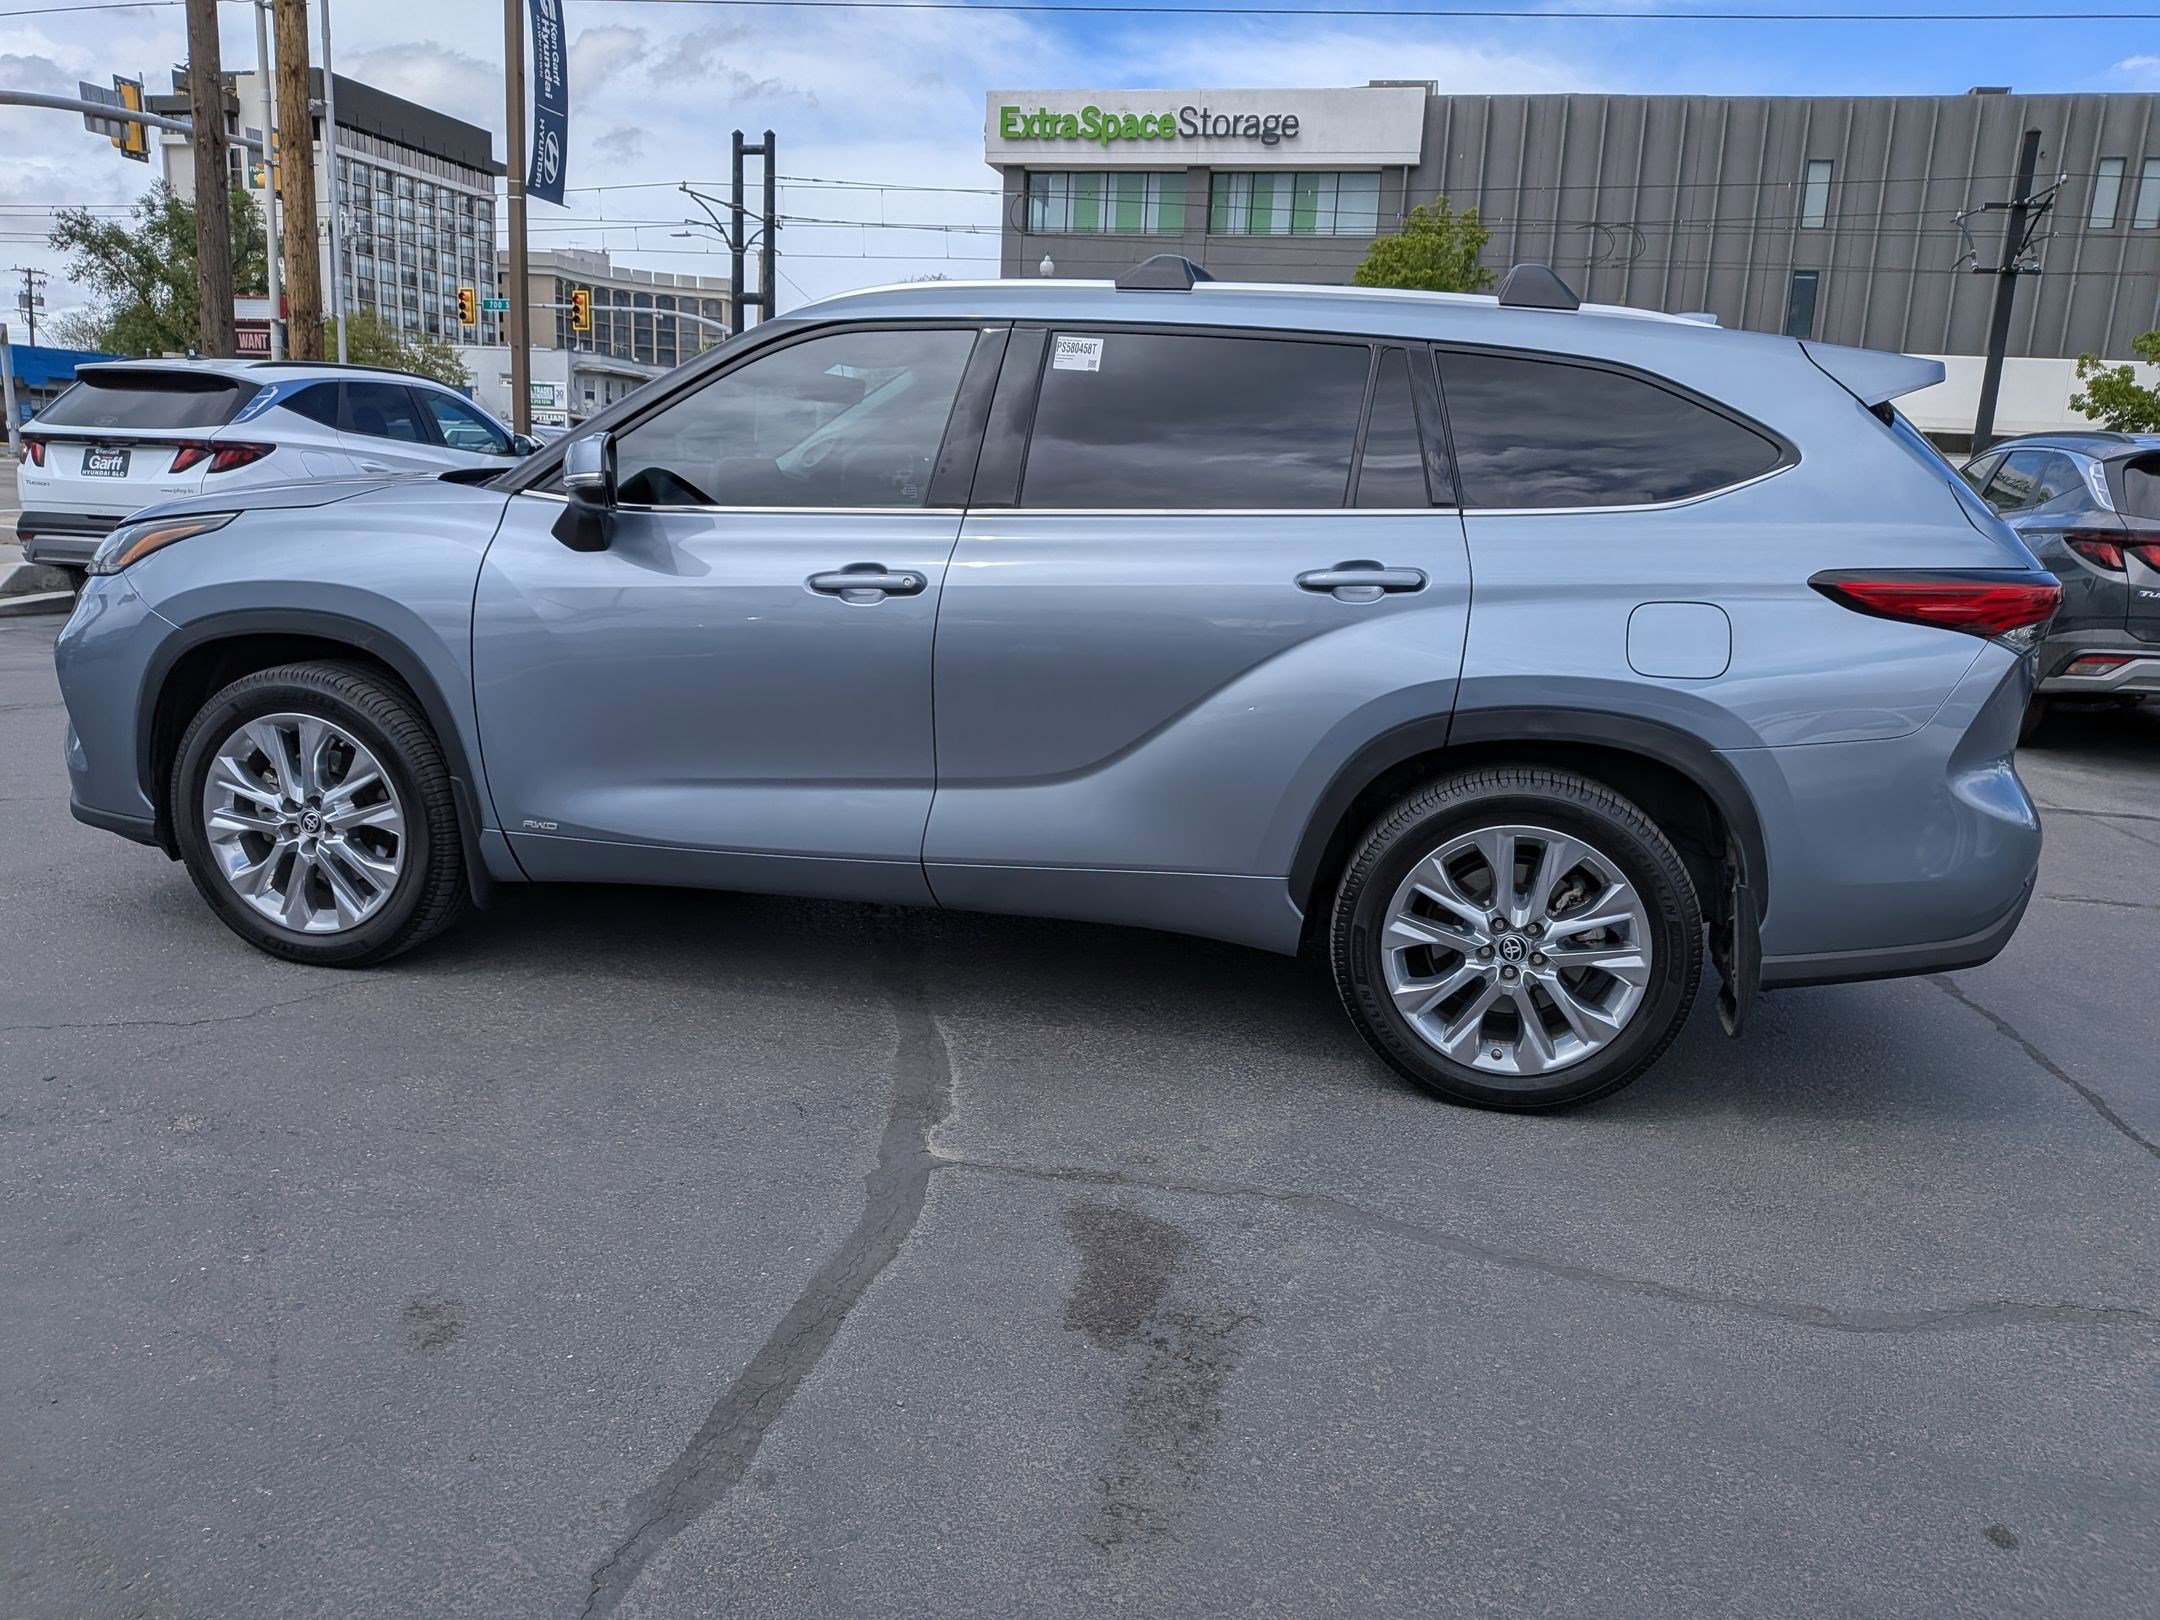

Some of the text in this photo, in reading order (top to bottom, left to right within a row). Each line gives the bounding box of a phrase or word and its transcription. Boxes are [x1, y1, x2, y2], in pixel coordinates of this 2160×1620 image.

[536, 14, 544, 78] DOWNTOWN
[541, 17, 553, 100] Hyundai
[550, 21, 561, 87] Ken Garff
[535, 118, 545, 189] HYUNDAI
[489, 301, 510, 309] 700 S
[238, 333, 268, 349] WANT
[555, 389, 564, 399] 30
[530, 414, 564, 422] EPTILIAN
[88, 455, 124, 470] Garff
[522, 819, 559, 830] AWD
